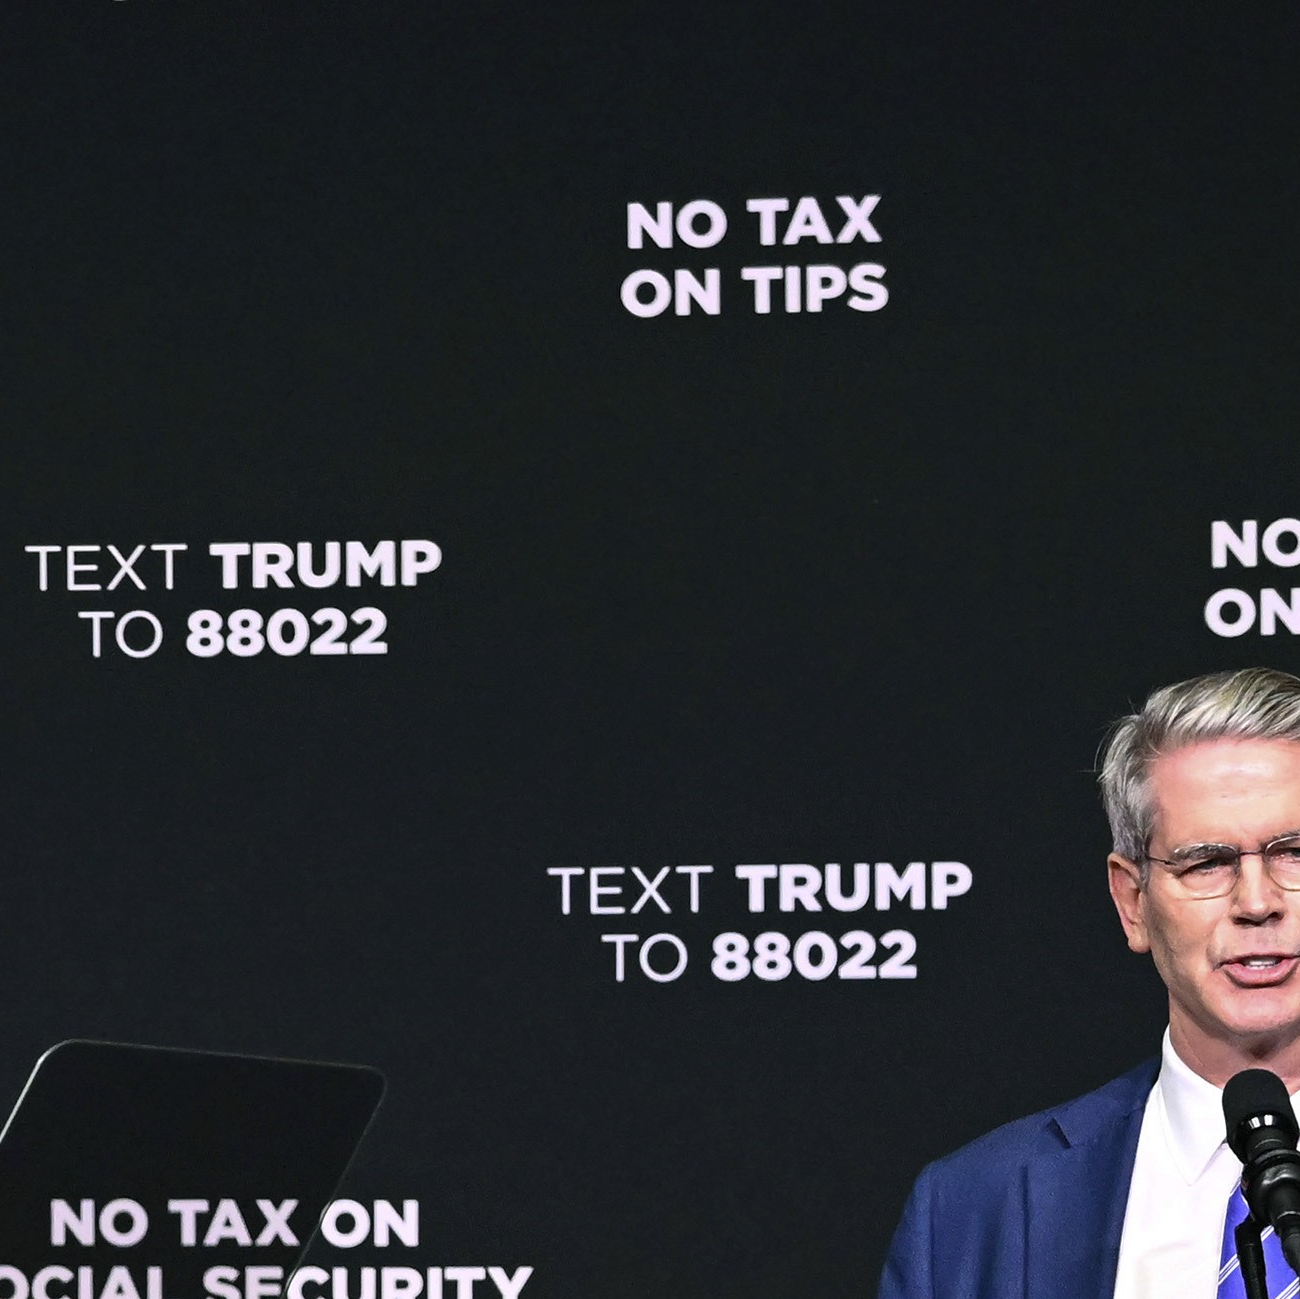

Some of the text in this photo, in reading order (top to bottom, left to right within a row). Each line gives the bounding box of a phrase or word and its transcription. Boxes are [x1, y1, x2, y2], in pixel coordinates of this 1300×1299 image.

[627, 194, 882, 250] NO TAX
[620, 262, 889, 318] ON TIPS
[24, 539, 442, 592] TEXT TRUMP
[77, 606, 388, 659] TO 88022
[546, 861, 973, 915] TEXT TRUMP
[601, 929, 918, 983] TO 88022
[50, 1198, 419, 1248] NO TAX ON
